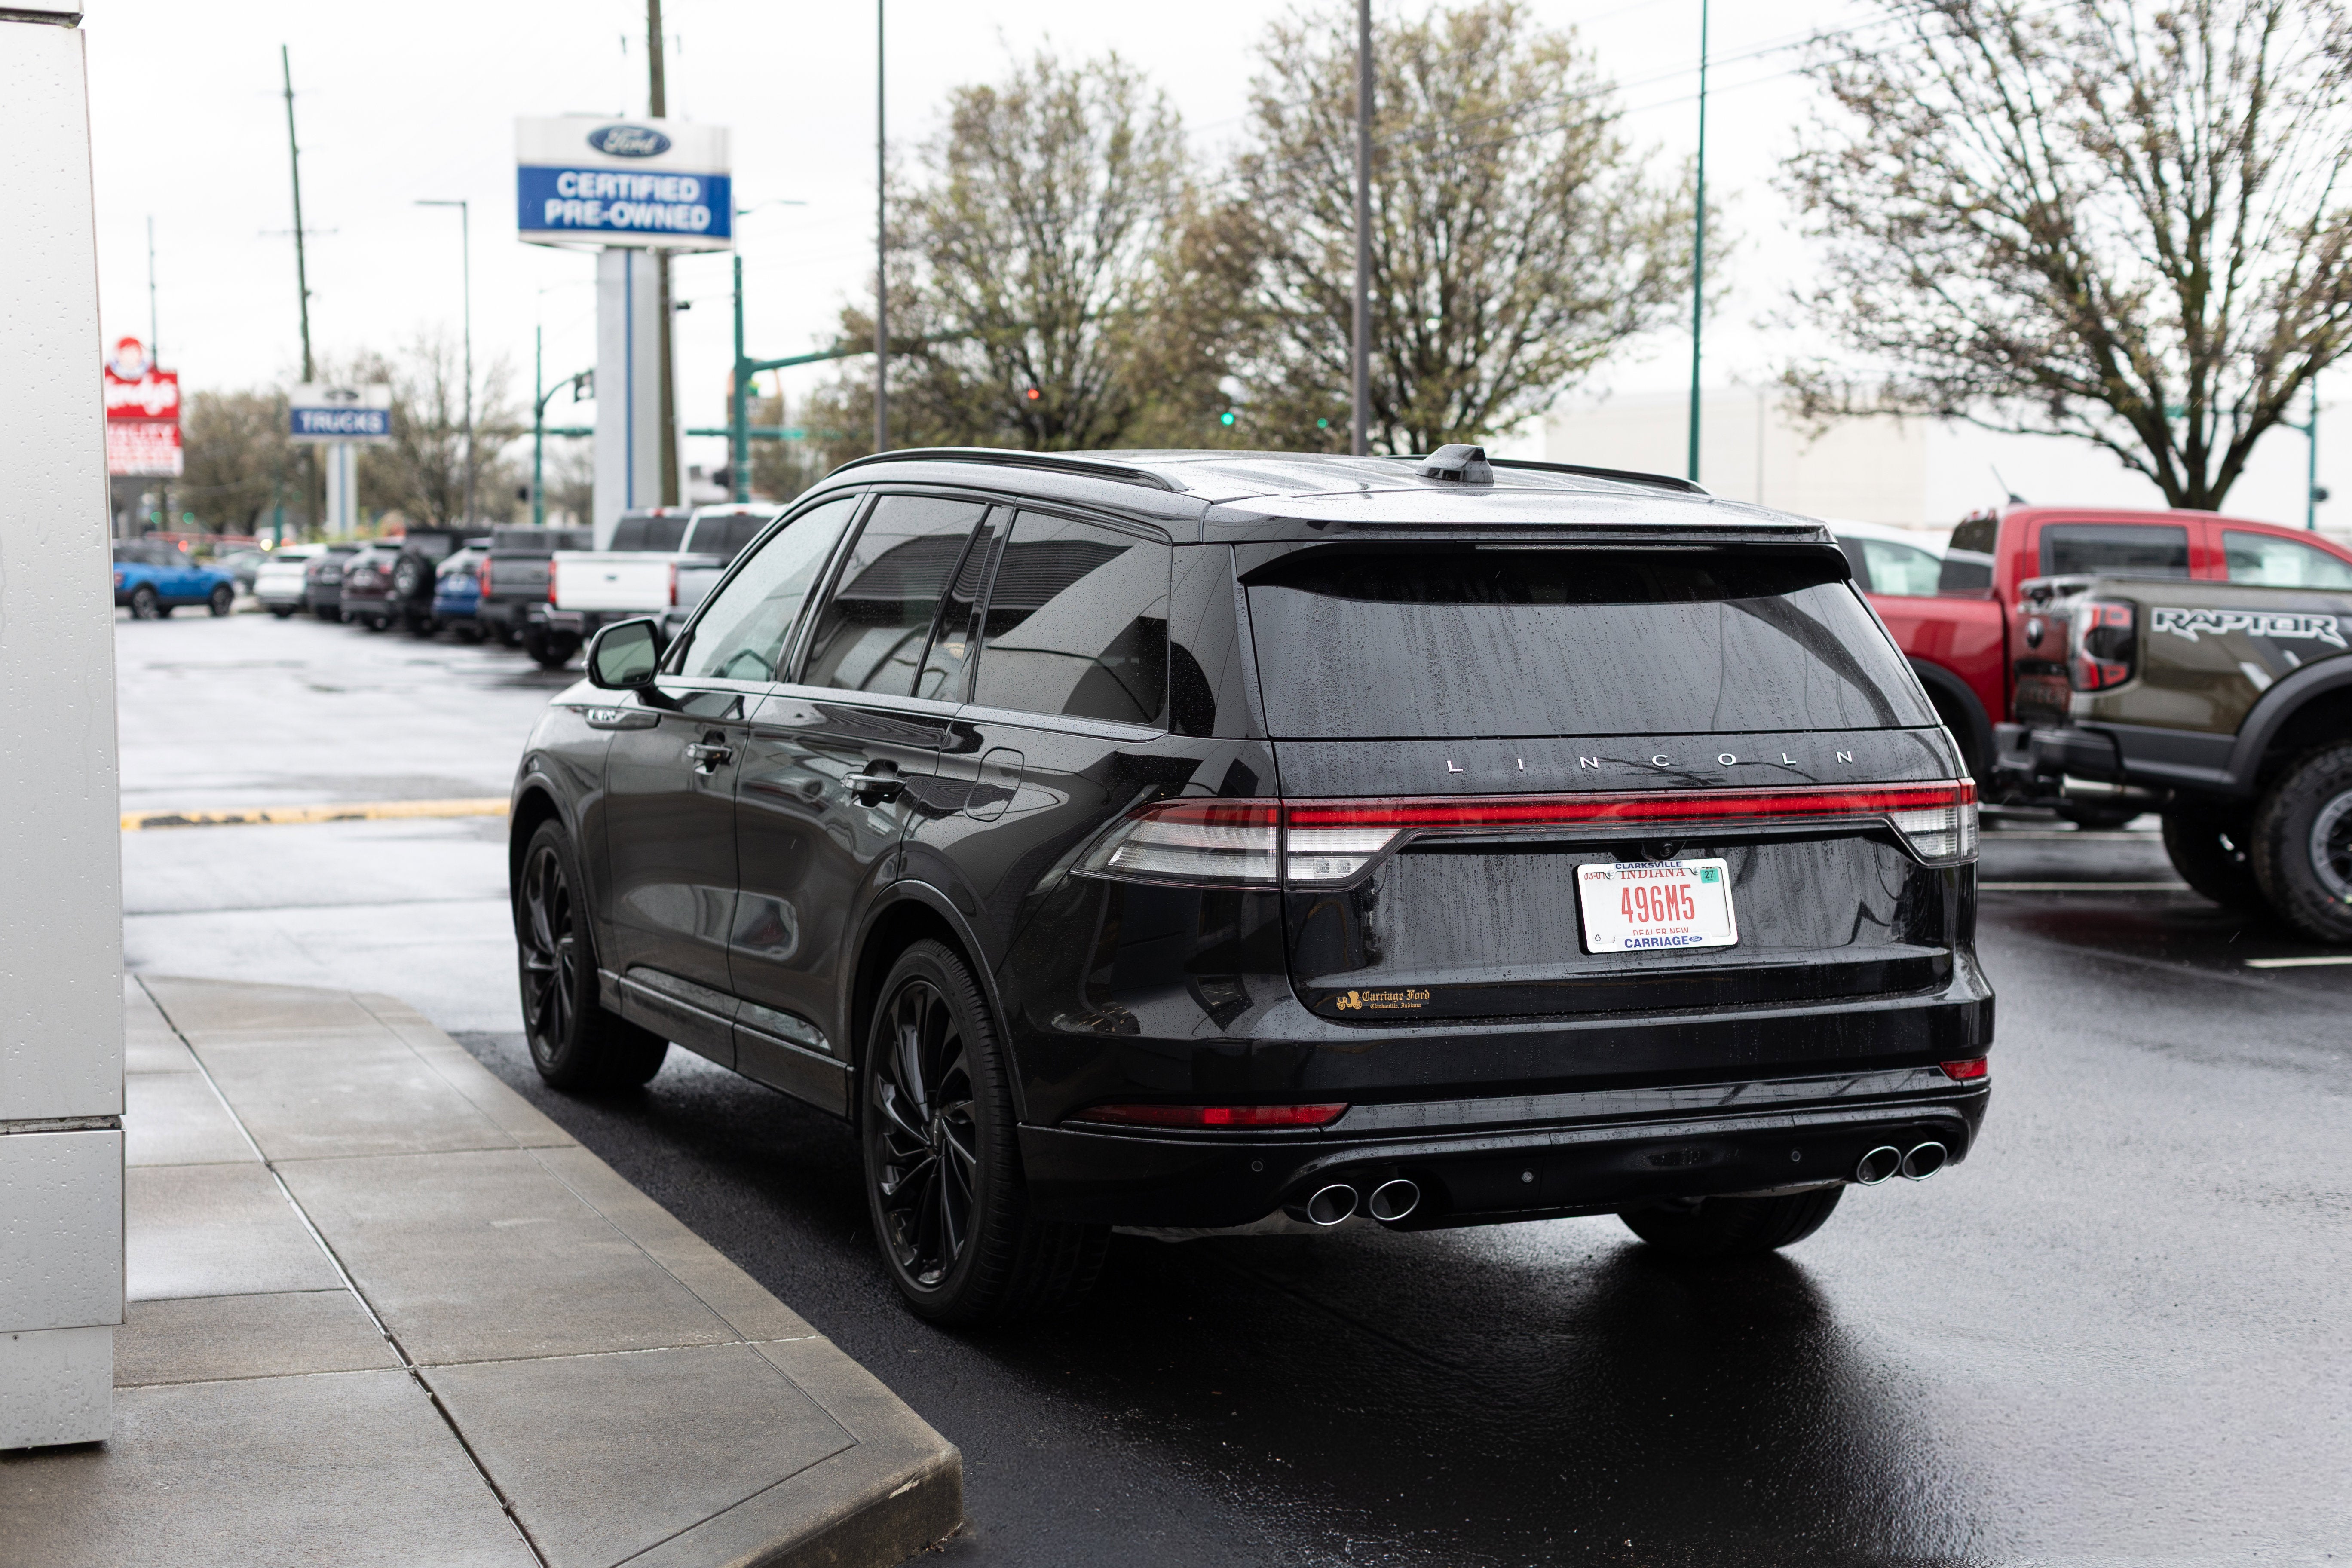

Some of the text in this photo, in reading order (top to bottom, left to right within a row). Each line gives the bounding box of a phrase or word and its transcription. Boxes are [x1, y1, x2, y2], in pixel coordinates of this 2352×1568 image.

[603, 128, 658, 154] Ford
[557, 171, 701, 202] CERTIFIED
[545, 198, 711, 231] PRE-OWNED
[300, 410, 383, 432] TRUCKS
[2151, 607, 2348, 649] RAPTOR
[1447, 750, 1852, 773] LINCOLN
[1621, 868, 1686, 879] INDIANA
[1705, 870, 1714, 879] 27
[1622, 884, 1695, 923] 496M5
[1625, 936, 1689, 948] CARRIAGE
[1362, 989, 1430, 1002] Carriage Ford
